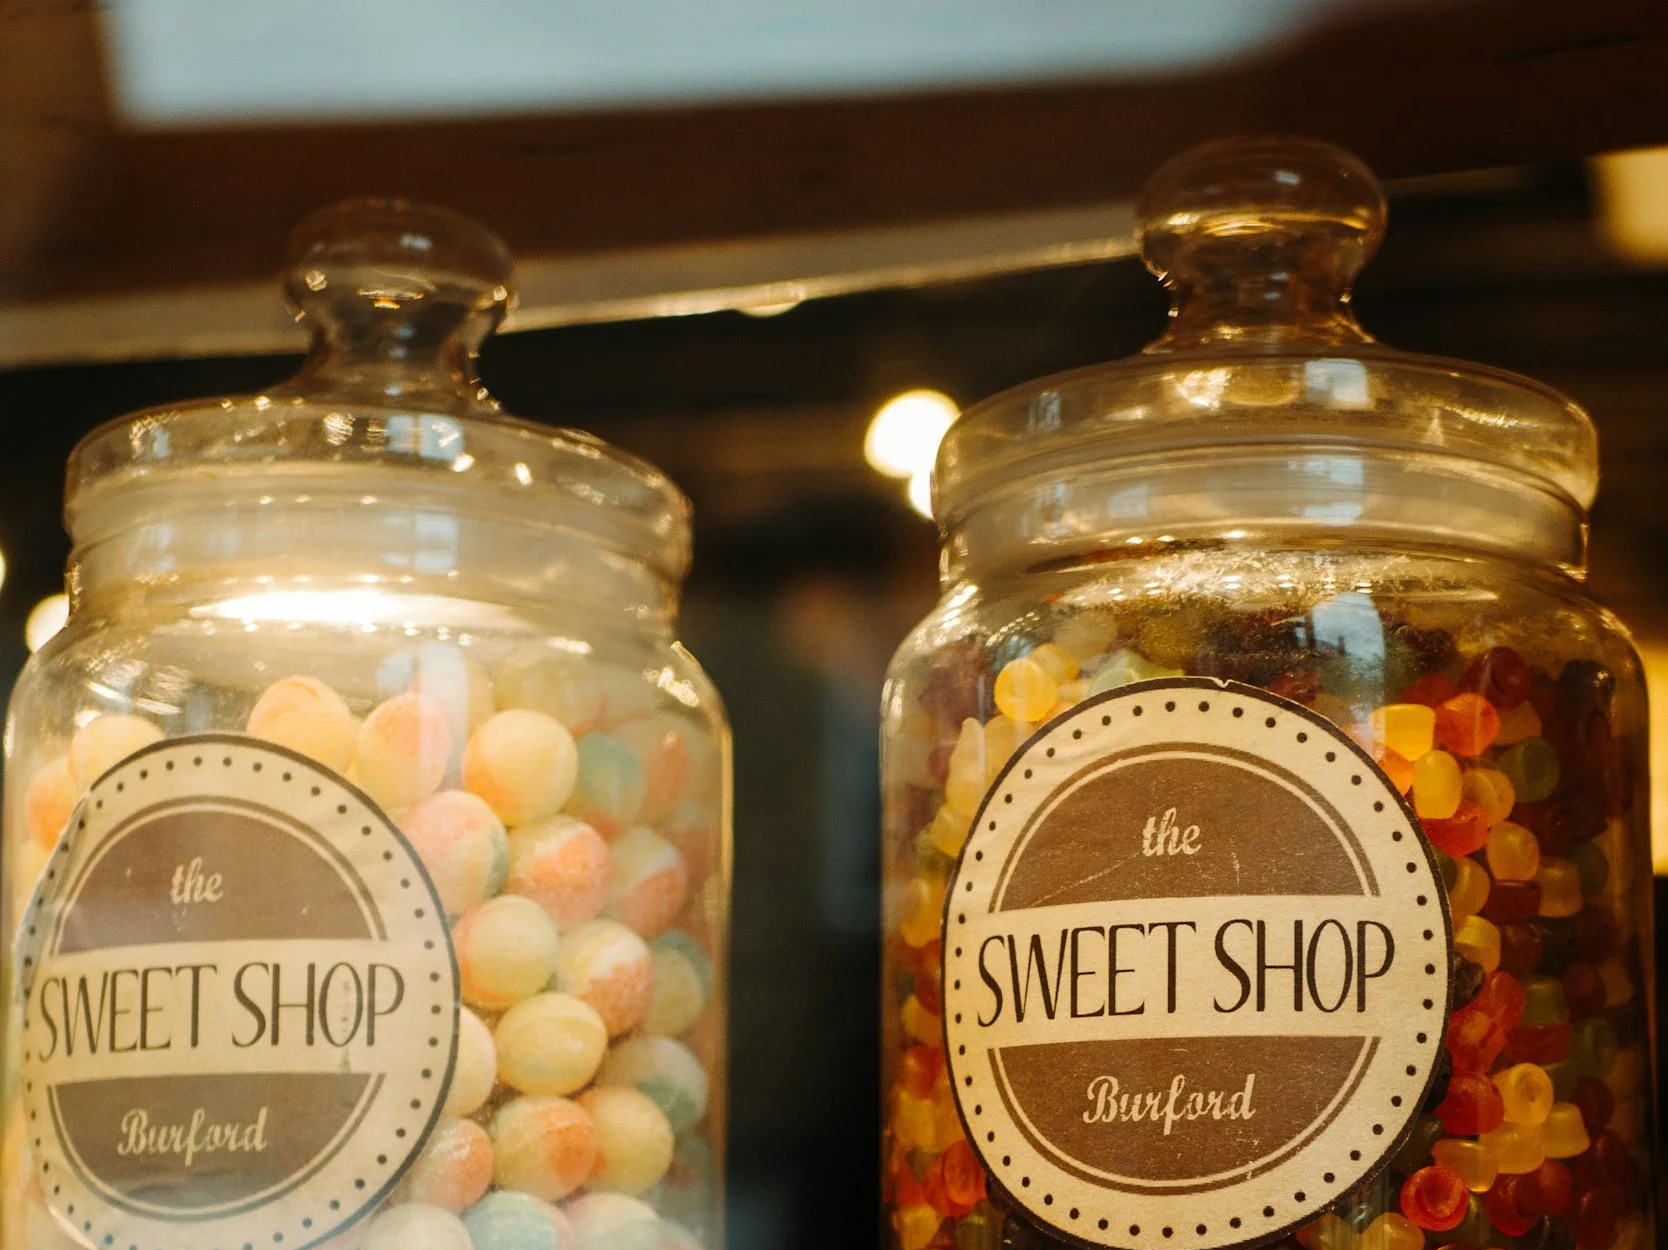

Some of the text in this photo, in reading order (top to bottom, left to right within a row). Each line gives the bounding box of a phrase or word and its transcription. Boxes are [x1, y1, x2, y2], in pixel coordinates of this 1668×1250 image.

[1141, 807, 1202, 858] the
[168, 856, 224, 904] the
[976, 918, 1396, 1029] SWEET SHOP
[38, 961, 406, 1063] SWEET SHOP
[1082, 1073, 1256, 1136] Burford
[117, 1106, 268, 1167] Burford
